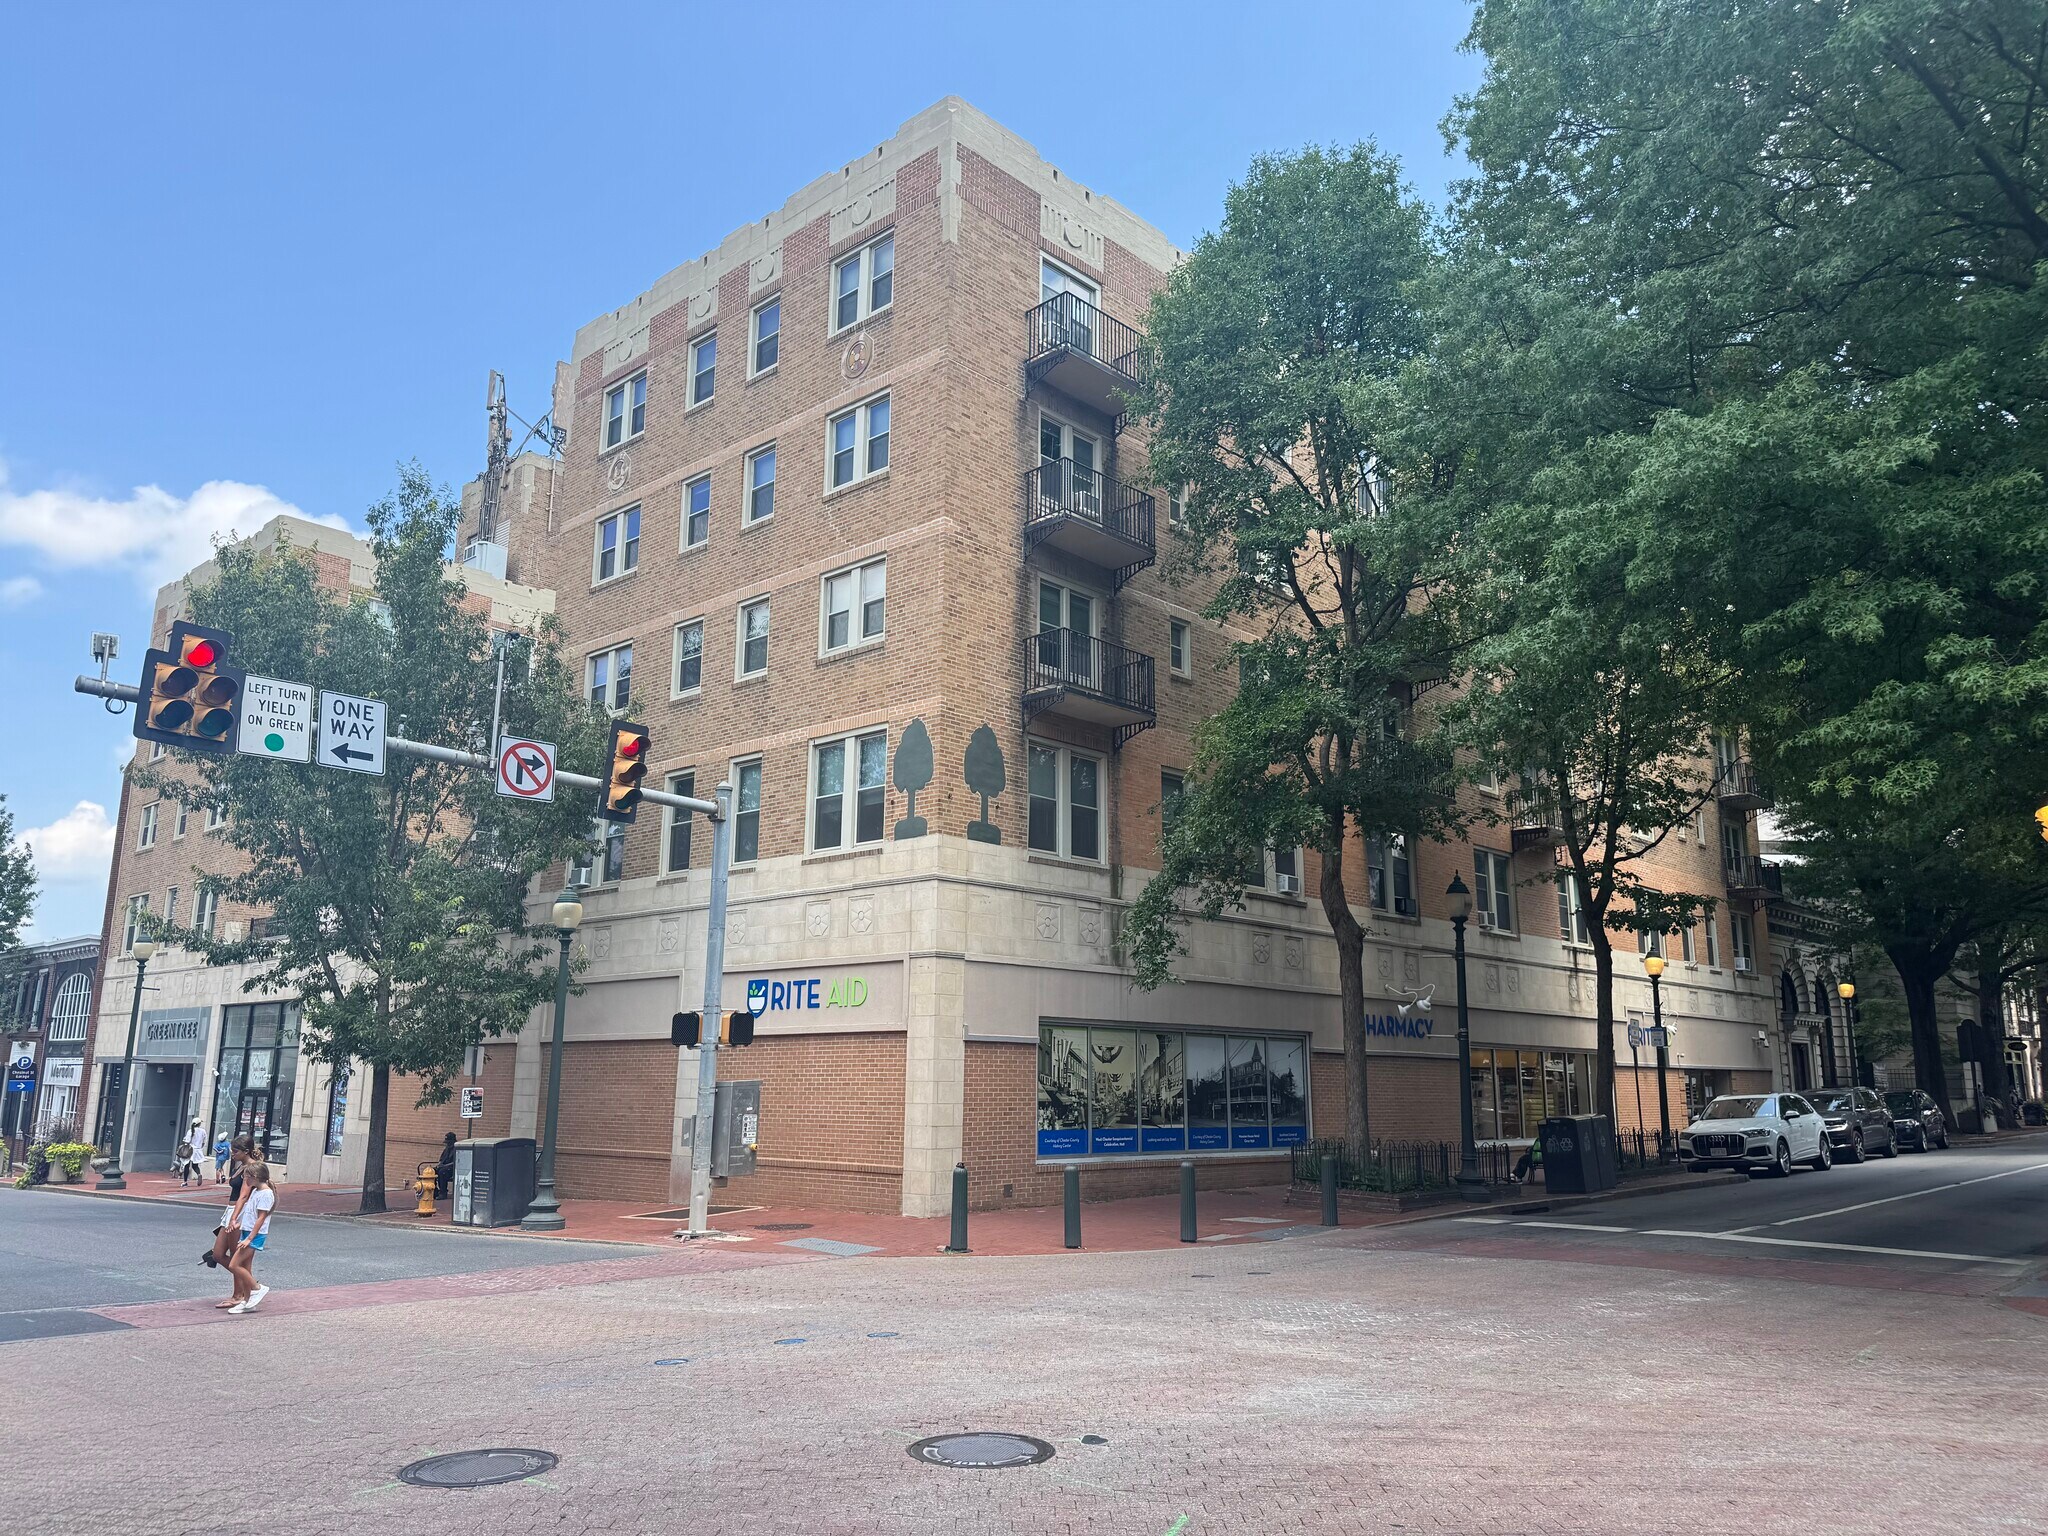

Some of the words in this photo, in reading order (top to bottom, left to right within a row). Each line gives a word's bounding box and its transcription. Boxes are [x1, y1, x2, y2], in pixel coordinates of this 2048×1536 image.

[248, 682, 273, 696] LEFT
[278, 687, 307, 702] TURN
[258, 698, 296, 716] YIELD
[333, 699, 374, 722] ONE
[248, 714, 263, 726] ON
[269, 717, 304, 733] GREEN
[331, 718, 375, 741] WAY
[771, 979, 821, 1011] RITE
[826, 977, 868, 1008] AID
[147, 1021, 198, 1040] GREENTREE
[1364, 1014, 1433, 1039] HARMACY
